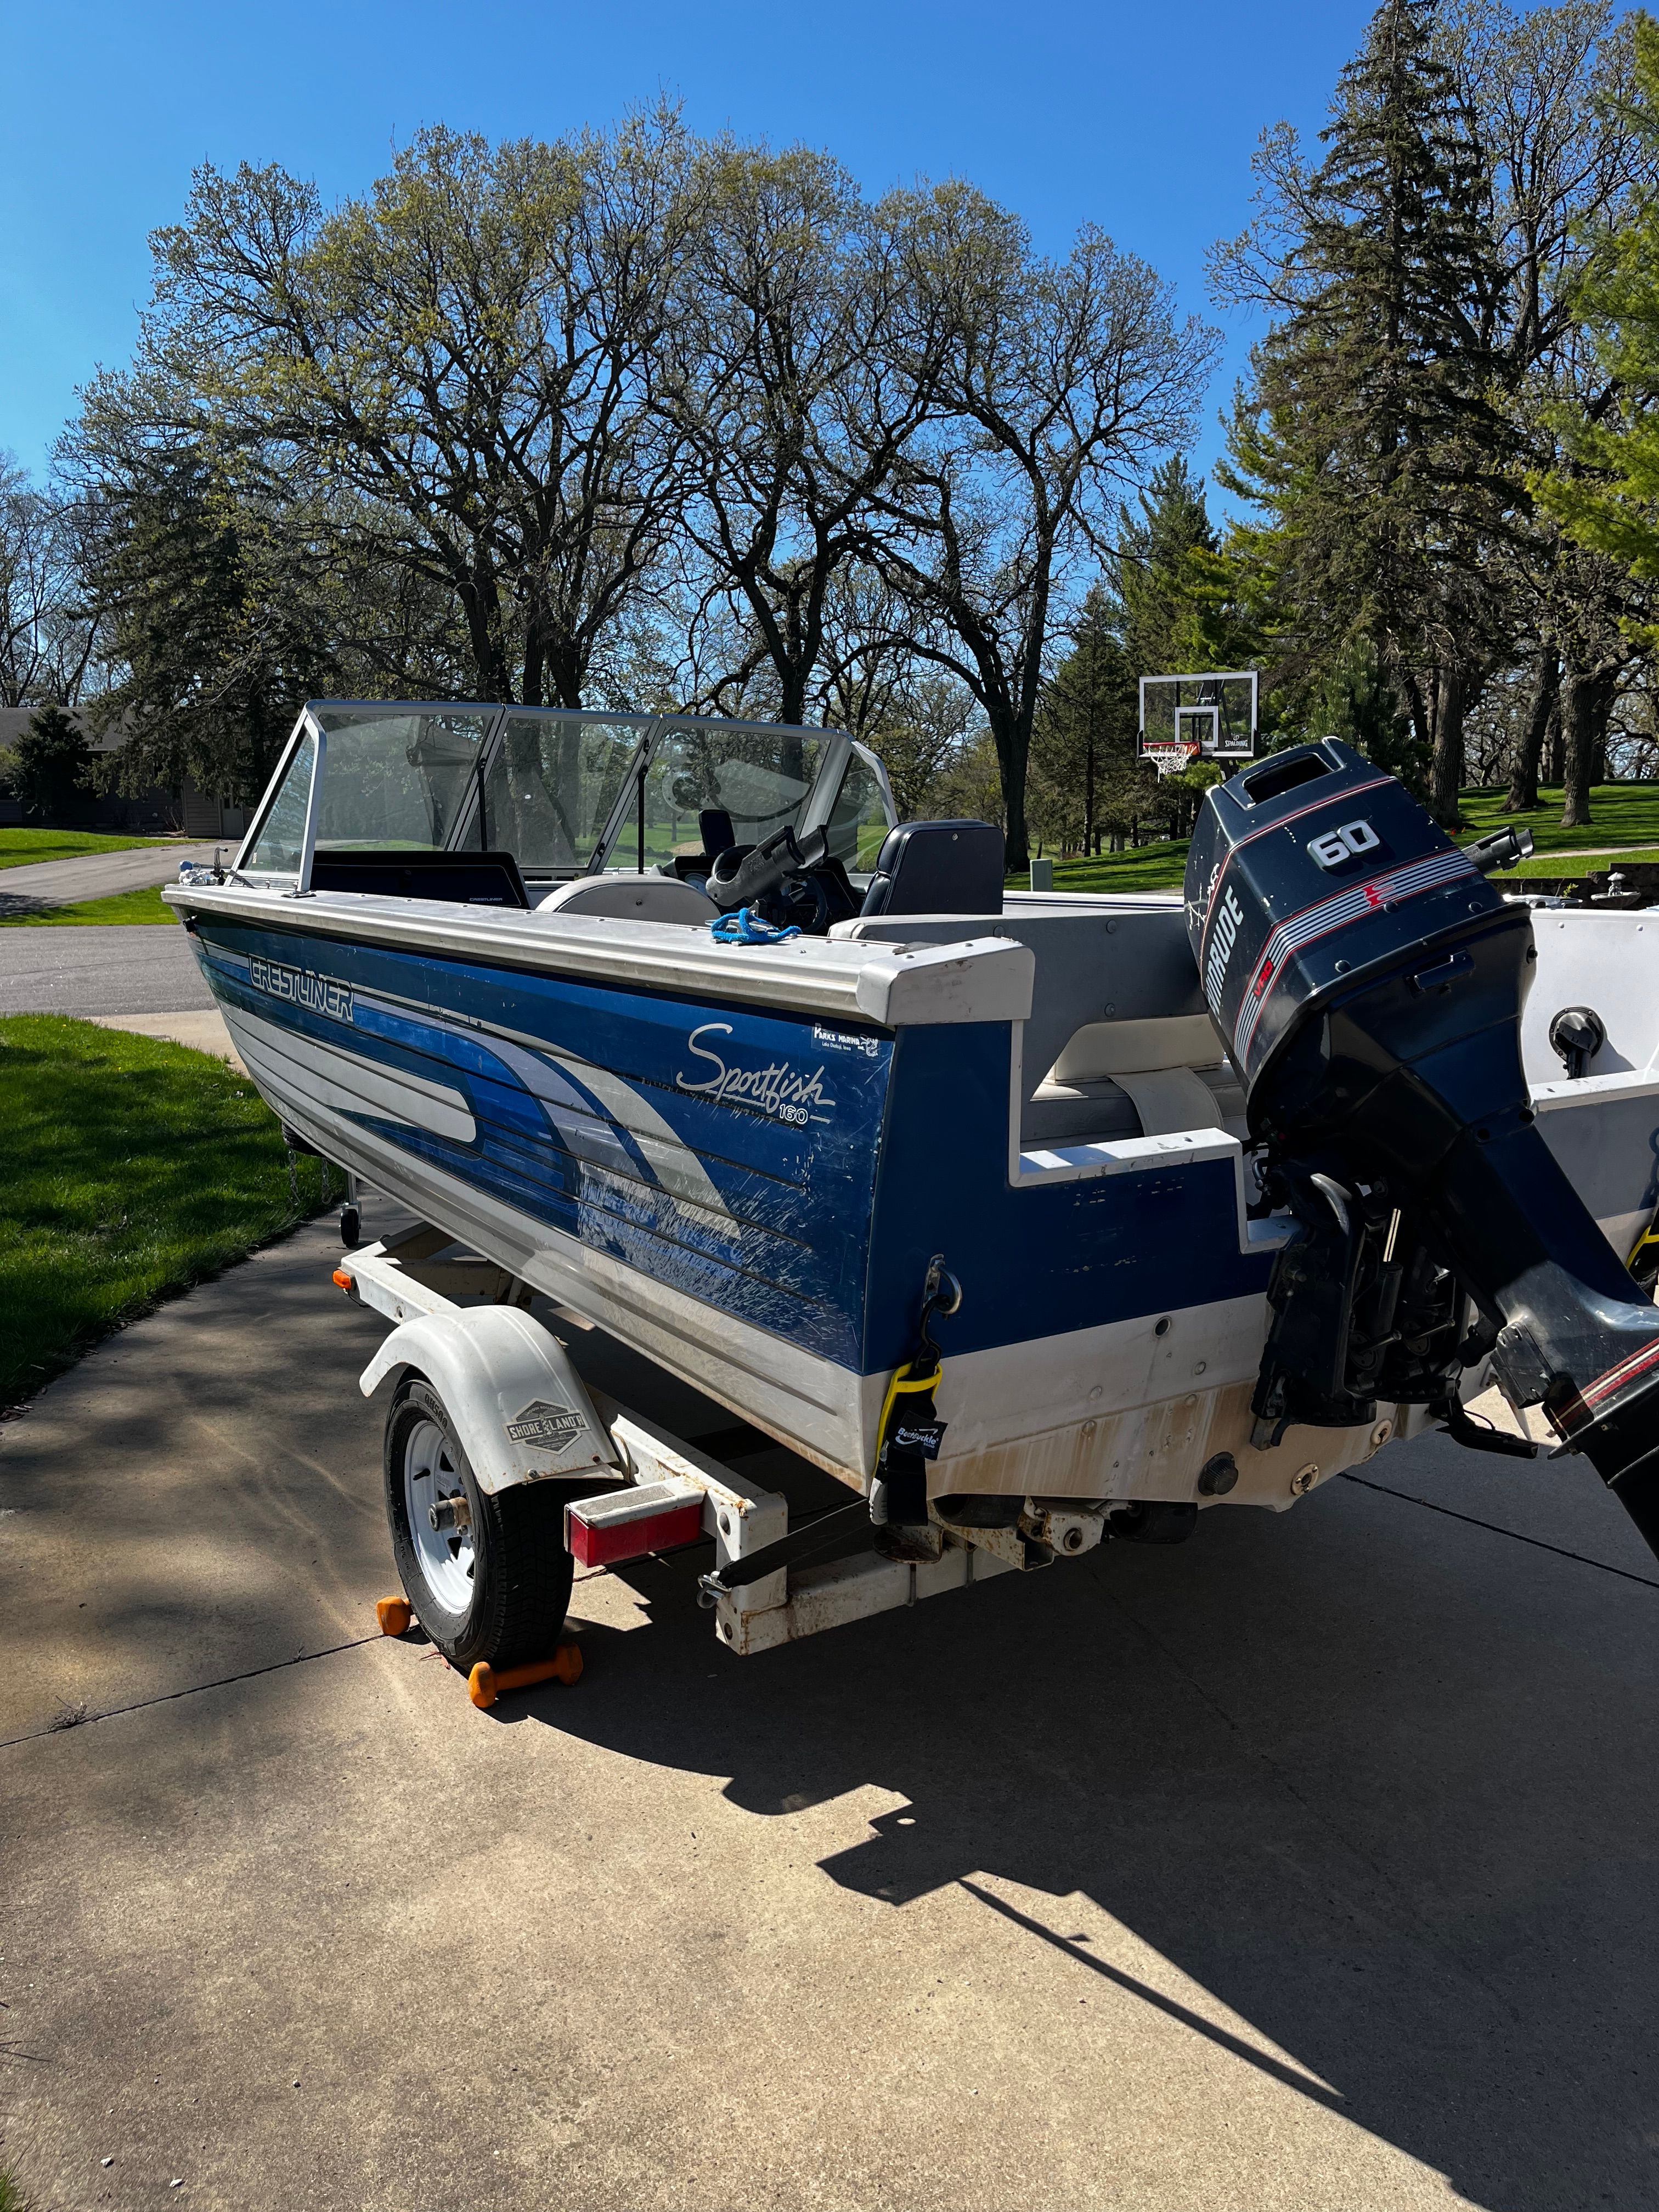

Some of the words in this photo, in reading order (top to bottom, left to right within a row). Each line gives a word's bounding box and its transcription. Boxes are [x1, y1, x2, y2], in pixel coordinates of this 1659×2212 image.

[1224, 739, 1248, 747] SPALDING
[1307, 820, 1380, 869] 60
[814, 1023, 836, 1041] PARKS
[838, 1035, 860, 1046] MARINA
[676, 1023, 836, 1113] Sportfish
[780, 1103, 808, 1125] 160
[509, 1422, 543, 1438] SHORE
[549, 1414, 585, 1431] LAND'R
